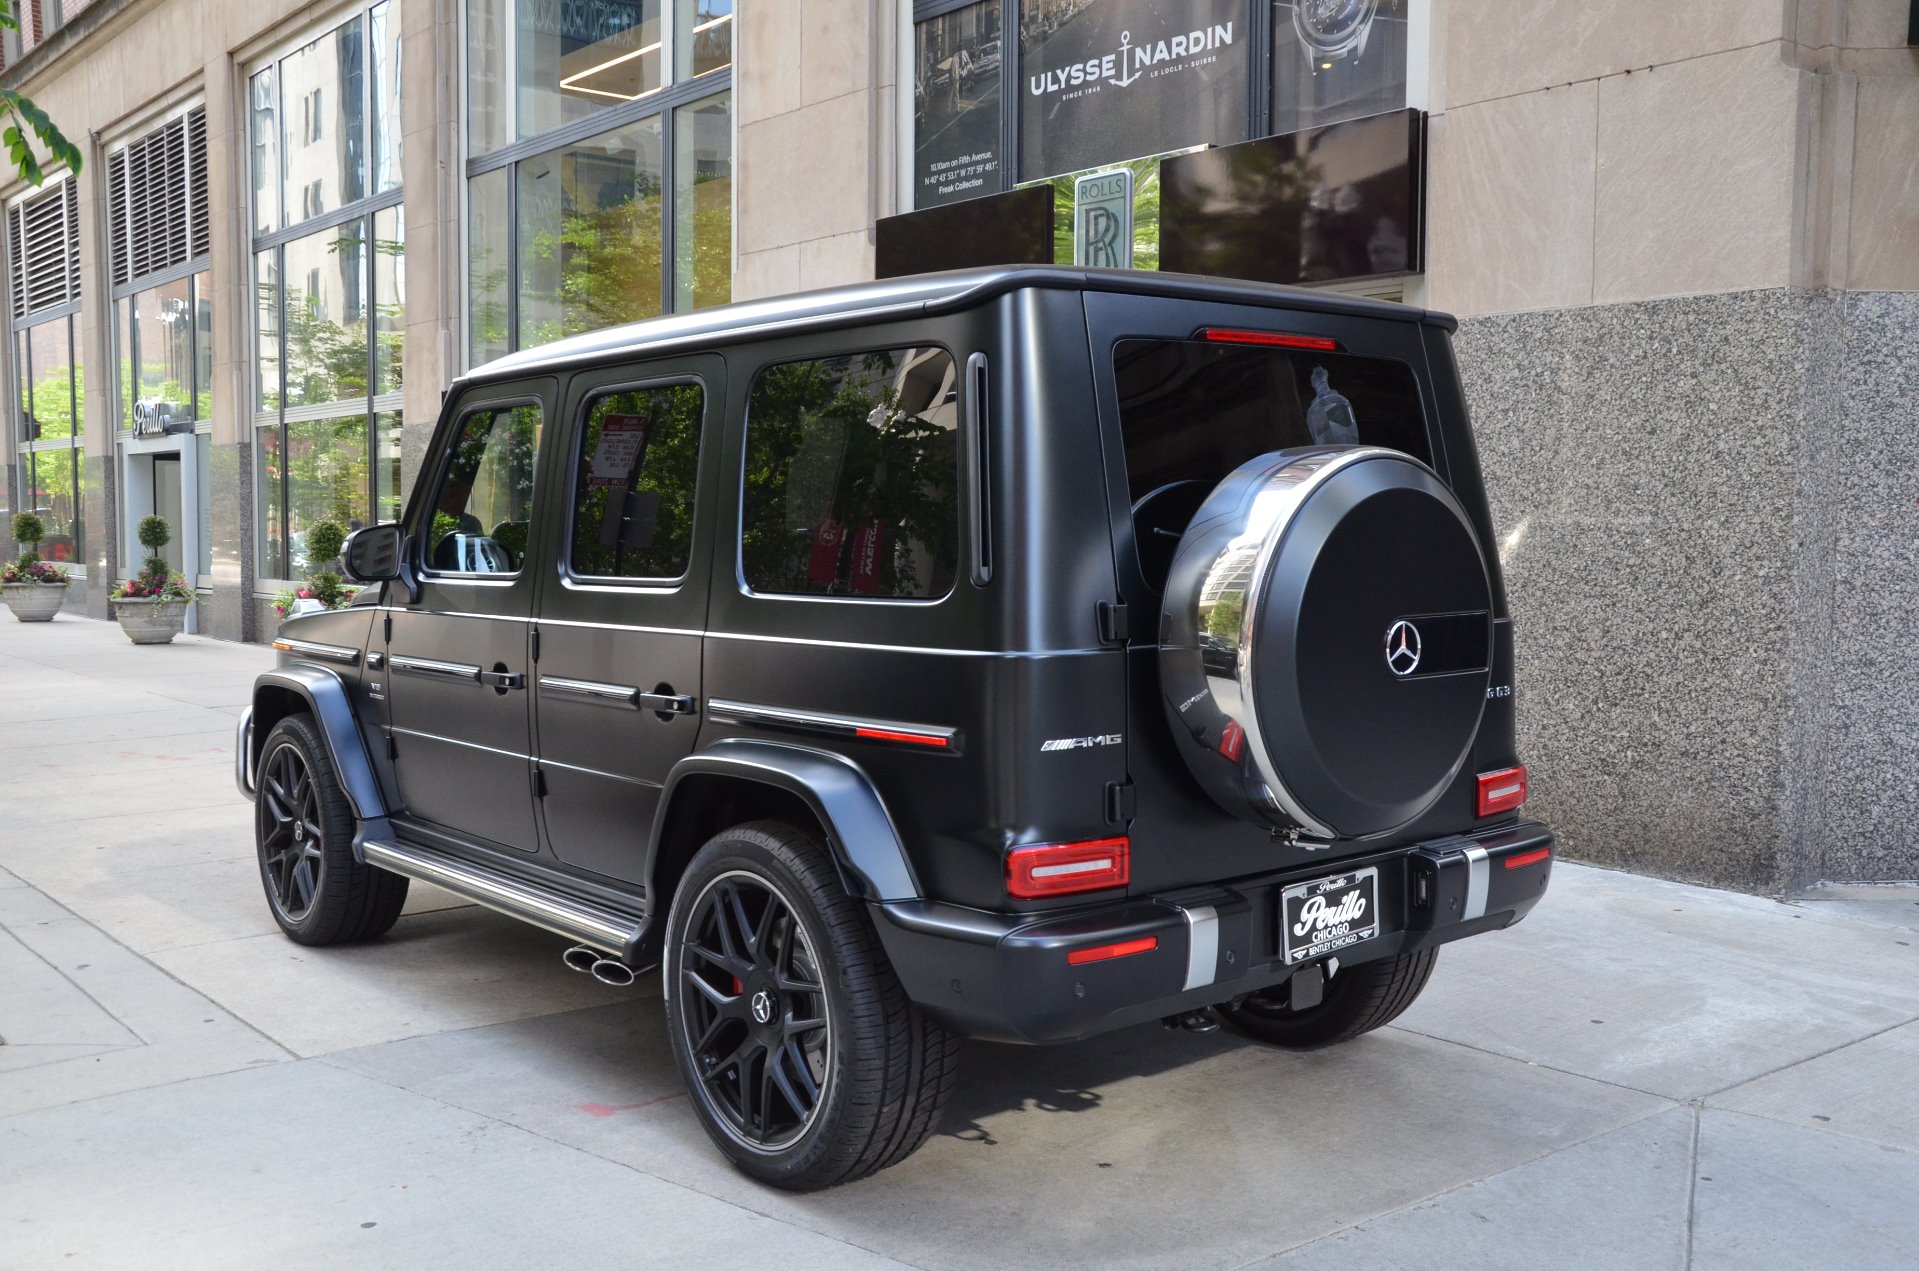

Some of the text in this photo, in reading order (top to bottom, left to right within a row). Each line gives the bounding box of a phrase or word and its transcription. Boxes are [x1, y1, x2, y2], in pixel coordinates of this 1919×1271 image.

[1030, 21, 1233, 96] ULYSSE NARDIN
[1150, 70, 1159, 78] LE
[1160, 64, 1183, 75] LOCLE
[1190, 55, 1217, 68] SUISSE
[1062, 90, 1083, 101] SINCE
[959, 154, 970, 165] Fifth
[925, 177, 929, 186] N
[939, 178, 983, 194] Freak Collection
[1081, 179, 1122, 200] ROLLS
[133, 399, 165, 436] Perillo
[1066, 733, 1122, 750] AMG
[1316, 877, 1348, 894] Perillo
[1293, 889, 1367, 937] Perillo
[1312, 922, 1350, 944] CHICAGO
[1308, 933, 1358, 956] BENTLEY CHICAGO
